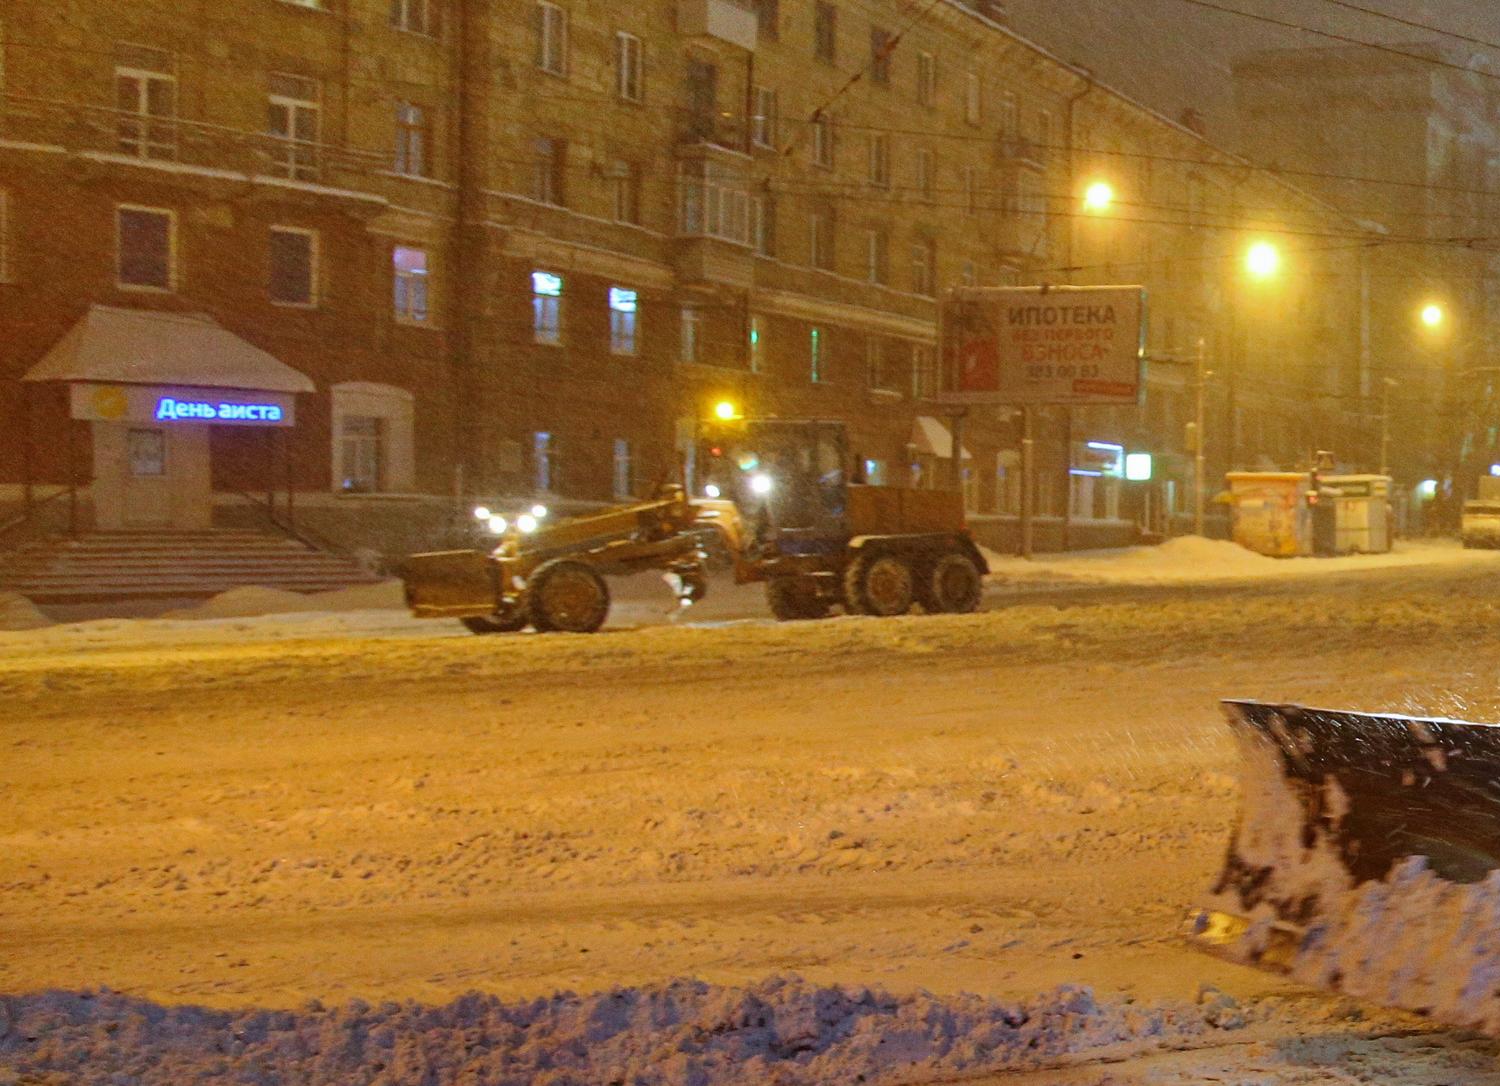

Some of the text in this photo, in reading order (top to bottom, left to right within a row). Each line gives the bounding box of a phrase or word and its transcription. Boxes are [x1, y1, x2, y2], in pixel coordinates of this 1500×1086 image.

[1008, 306, 1116, 325] ИПОТЕКА
[156, 398, 282, 421] День аиста
